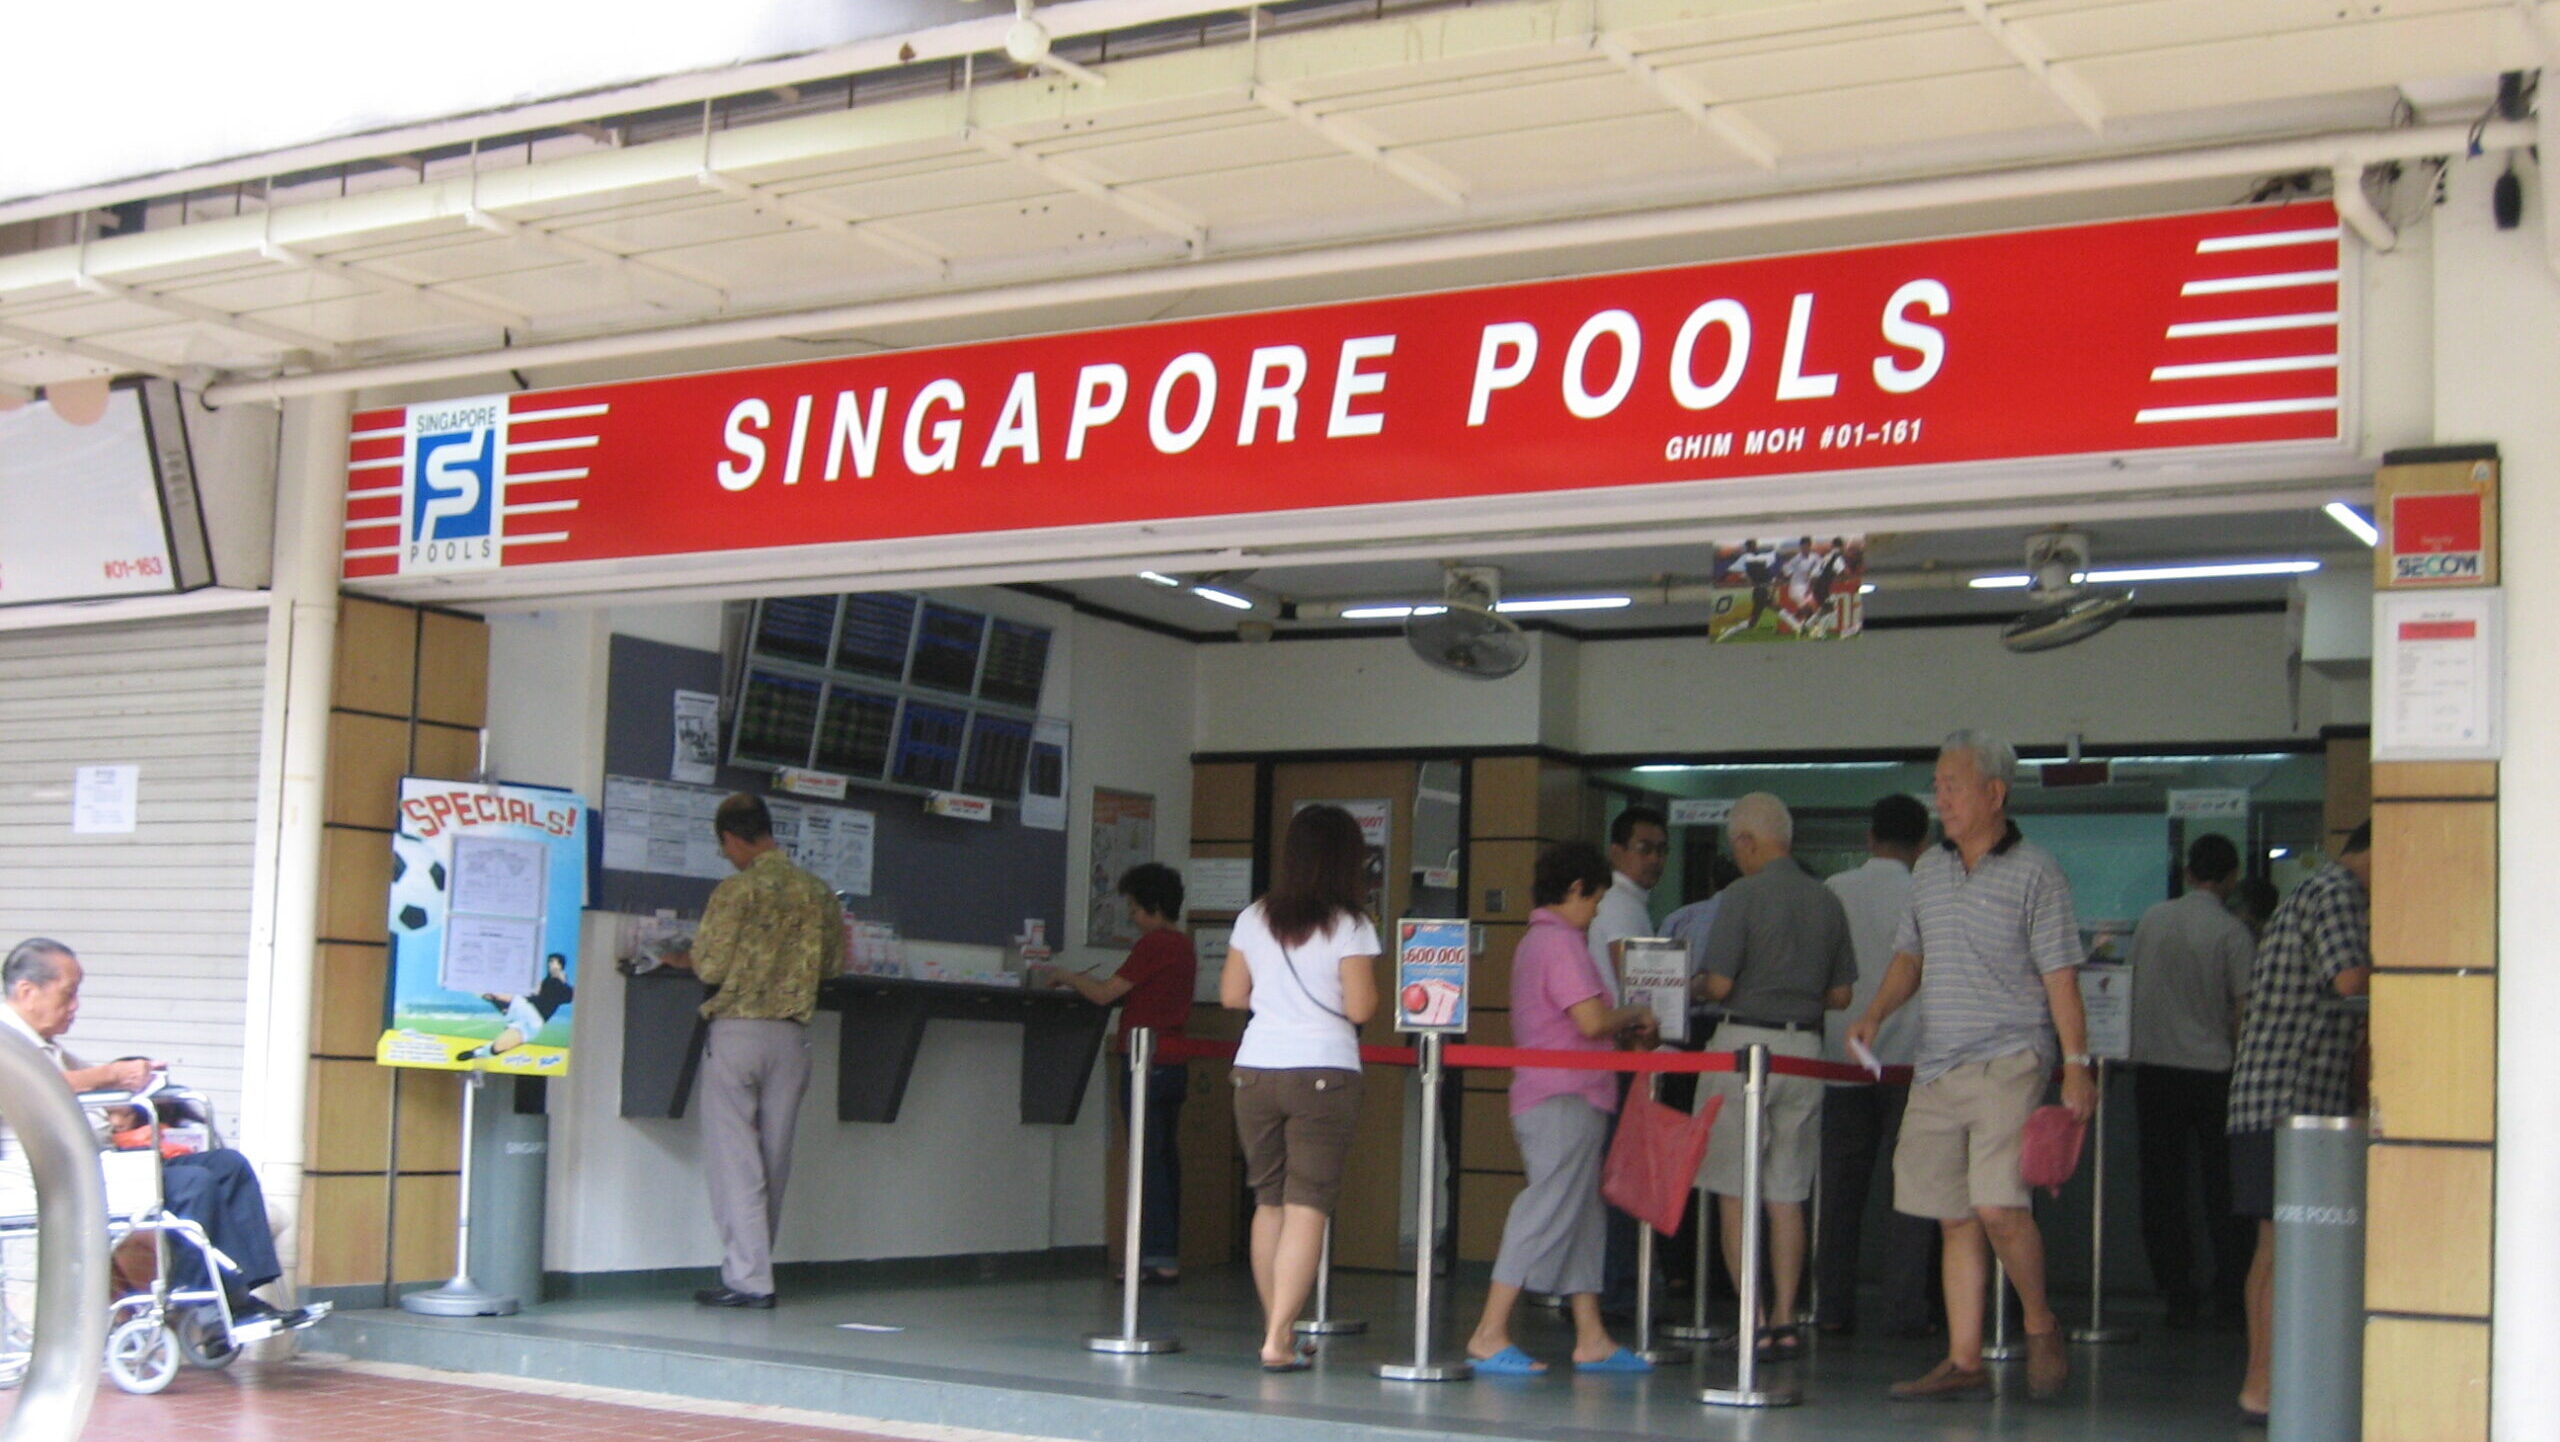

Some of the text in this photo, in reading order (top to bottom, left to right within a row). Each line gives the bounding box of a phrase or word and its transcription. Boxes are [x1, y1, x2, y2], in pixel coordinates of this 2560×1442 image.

[717, 278, 1950, 491] SINGAPORE POOLS
[417, 406, 496, 433] SINGAPORE
[1665, 418, 1922, 461] GHIM MOH #01-161
[410, 539, 490, 563] POOLS
[104, 556, 163, 579] #01-163
[2397, 555, 2477, 577] SECOM
[402, 792, 577, 838] SPECIALS!
